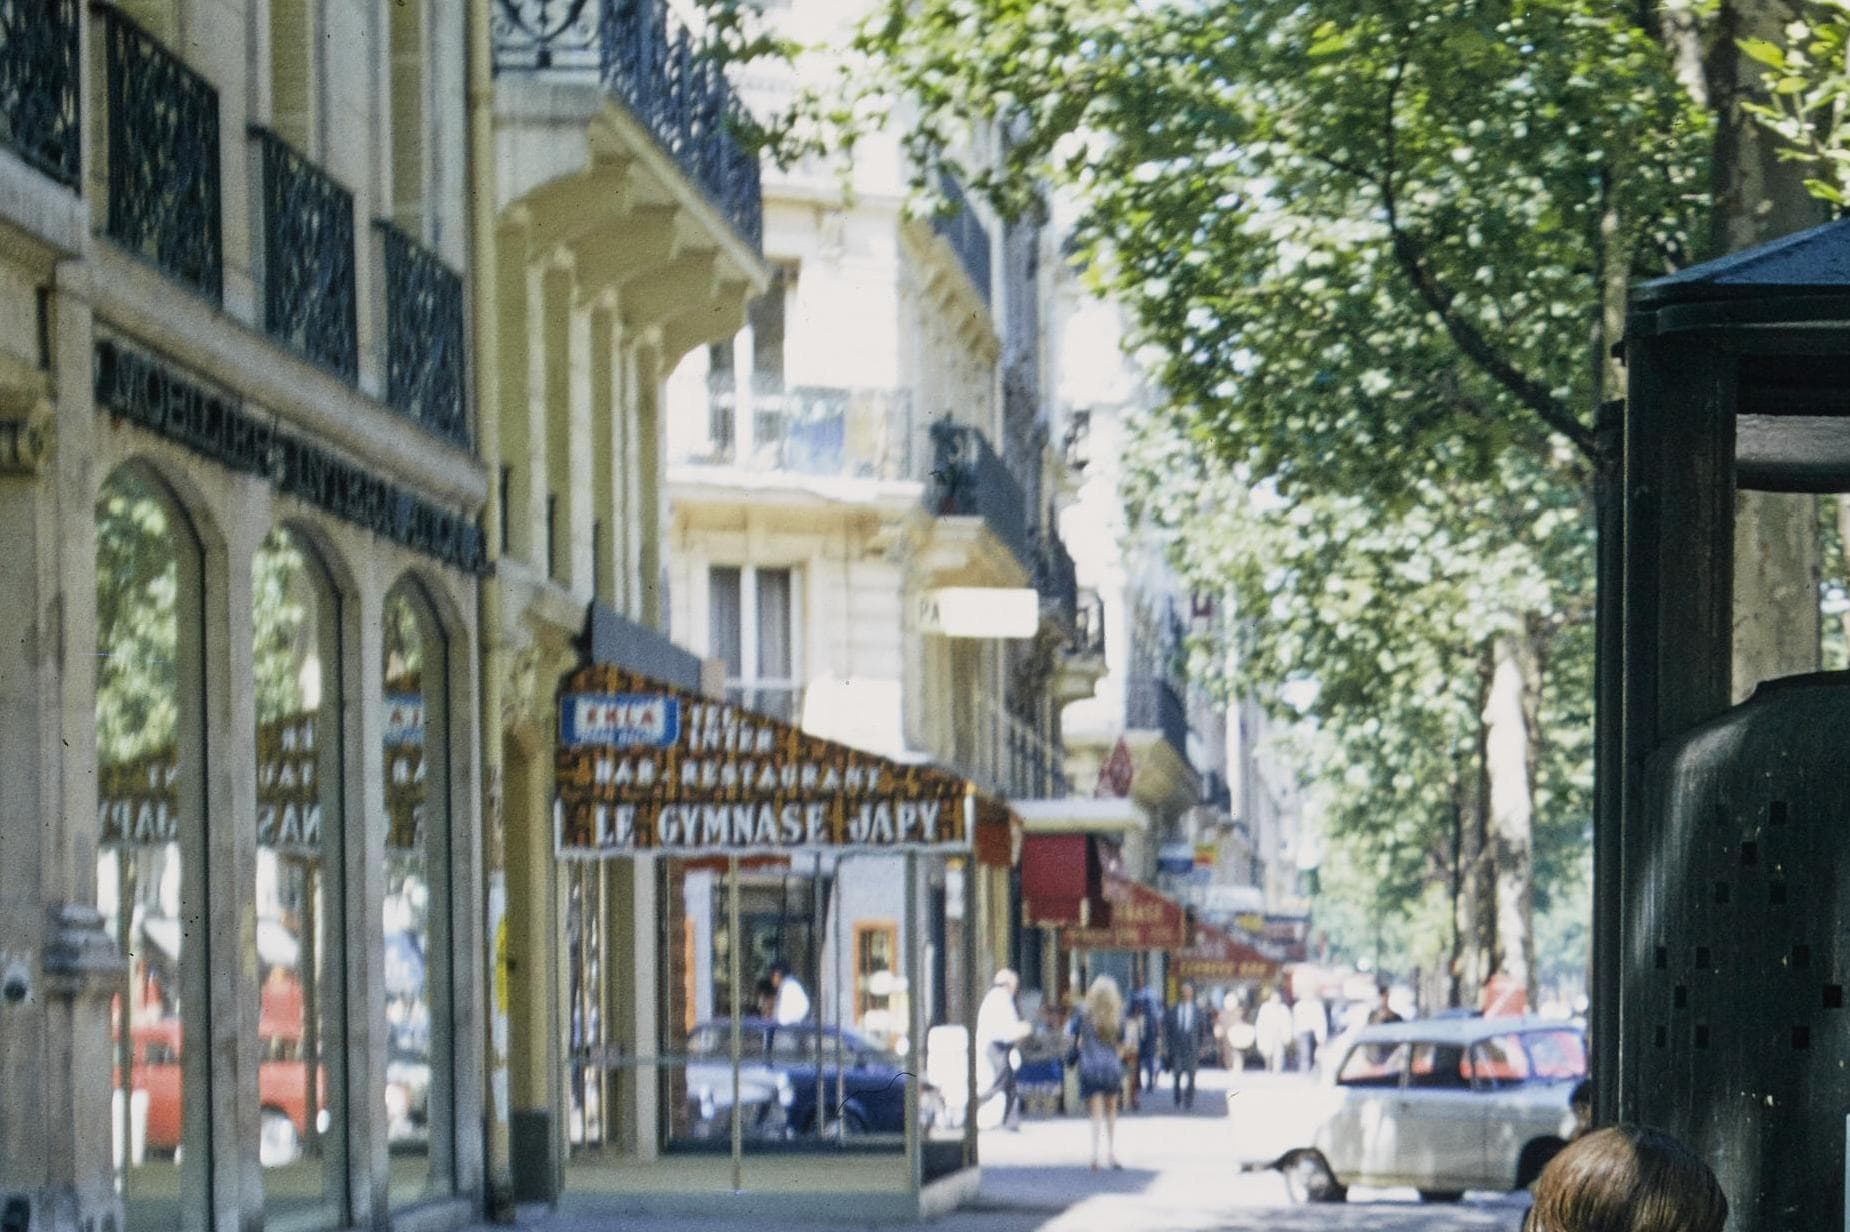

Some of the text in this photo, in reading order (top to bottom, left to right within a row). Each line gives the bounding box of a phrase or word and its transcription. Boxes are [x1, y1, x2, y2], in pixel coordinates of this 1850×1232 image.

[681, 760, 880, 793] RESTAURANT
[594, 800, 942, 846] LE GYMNASE JAPY
